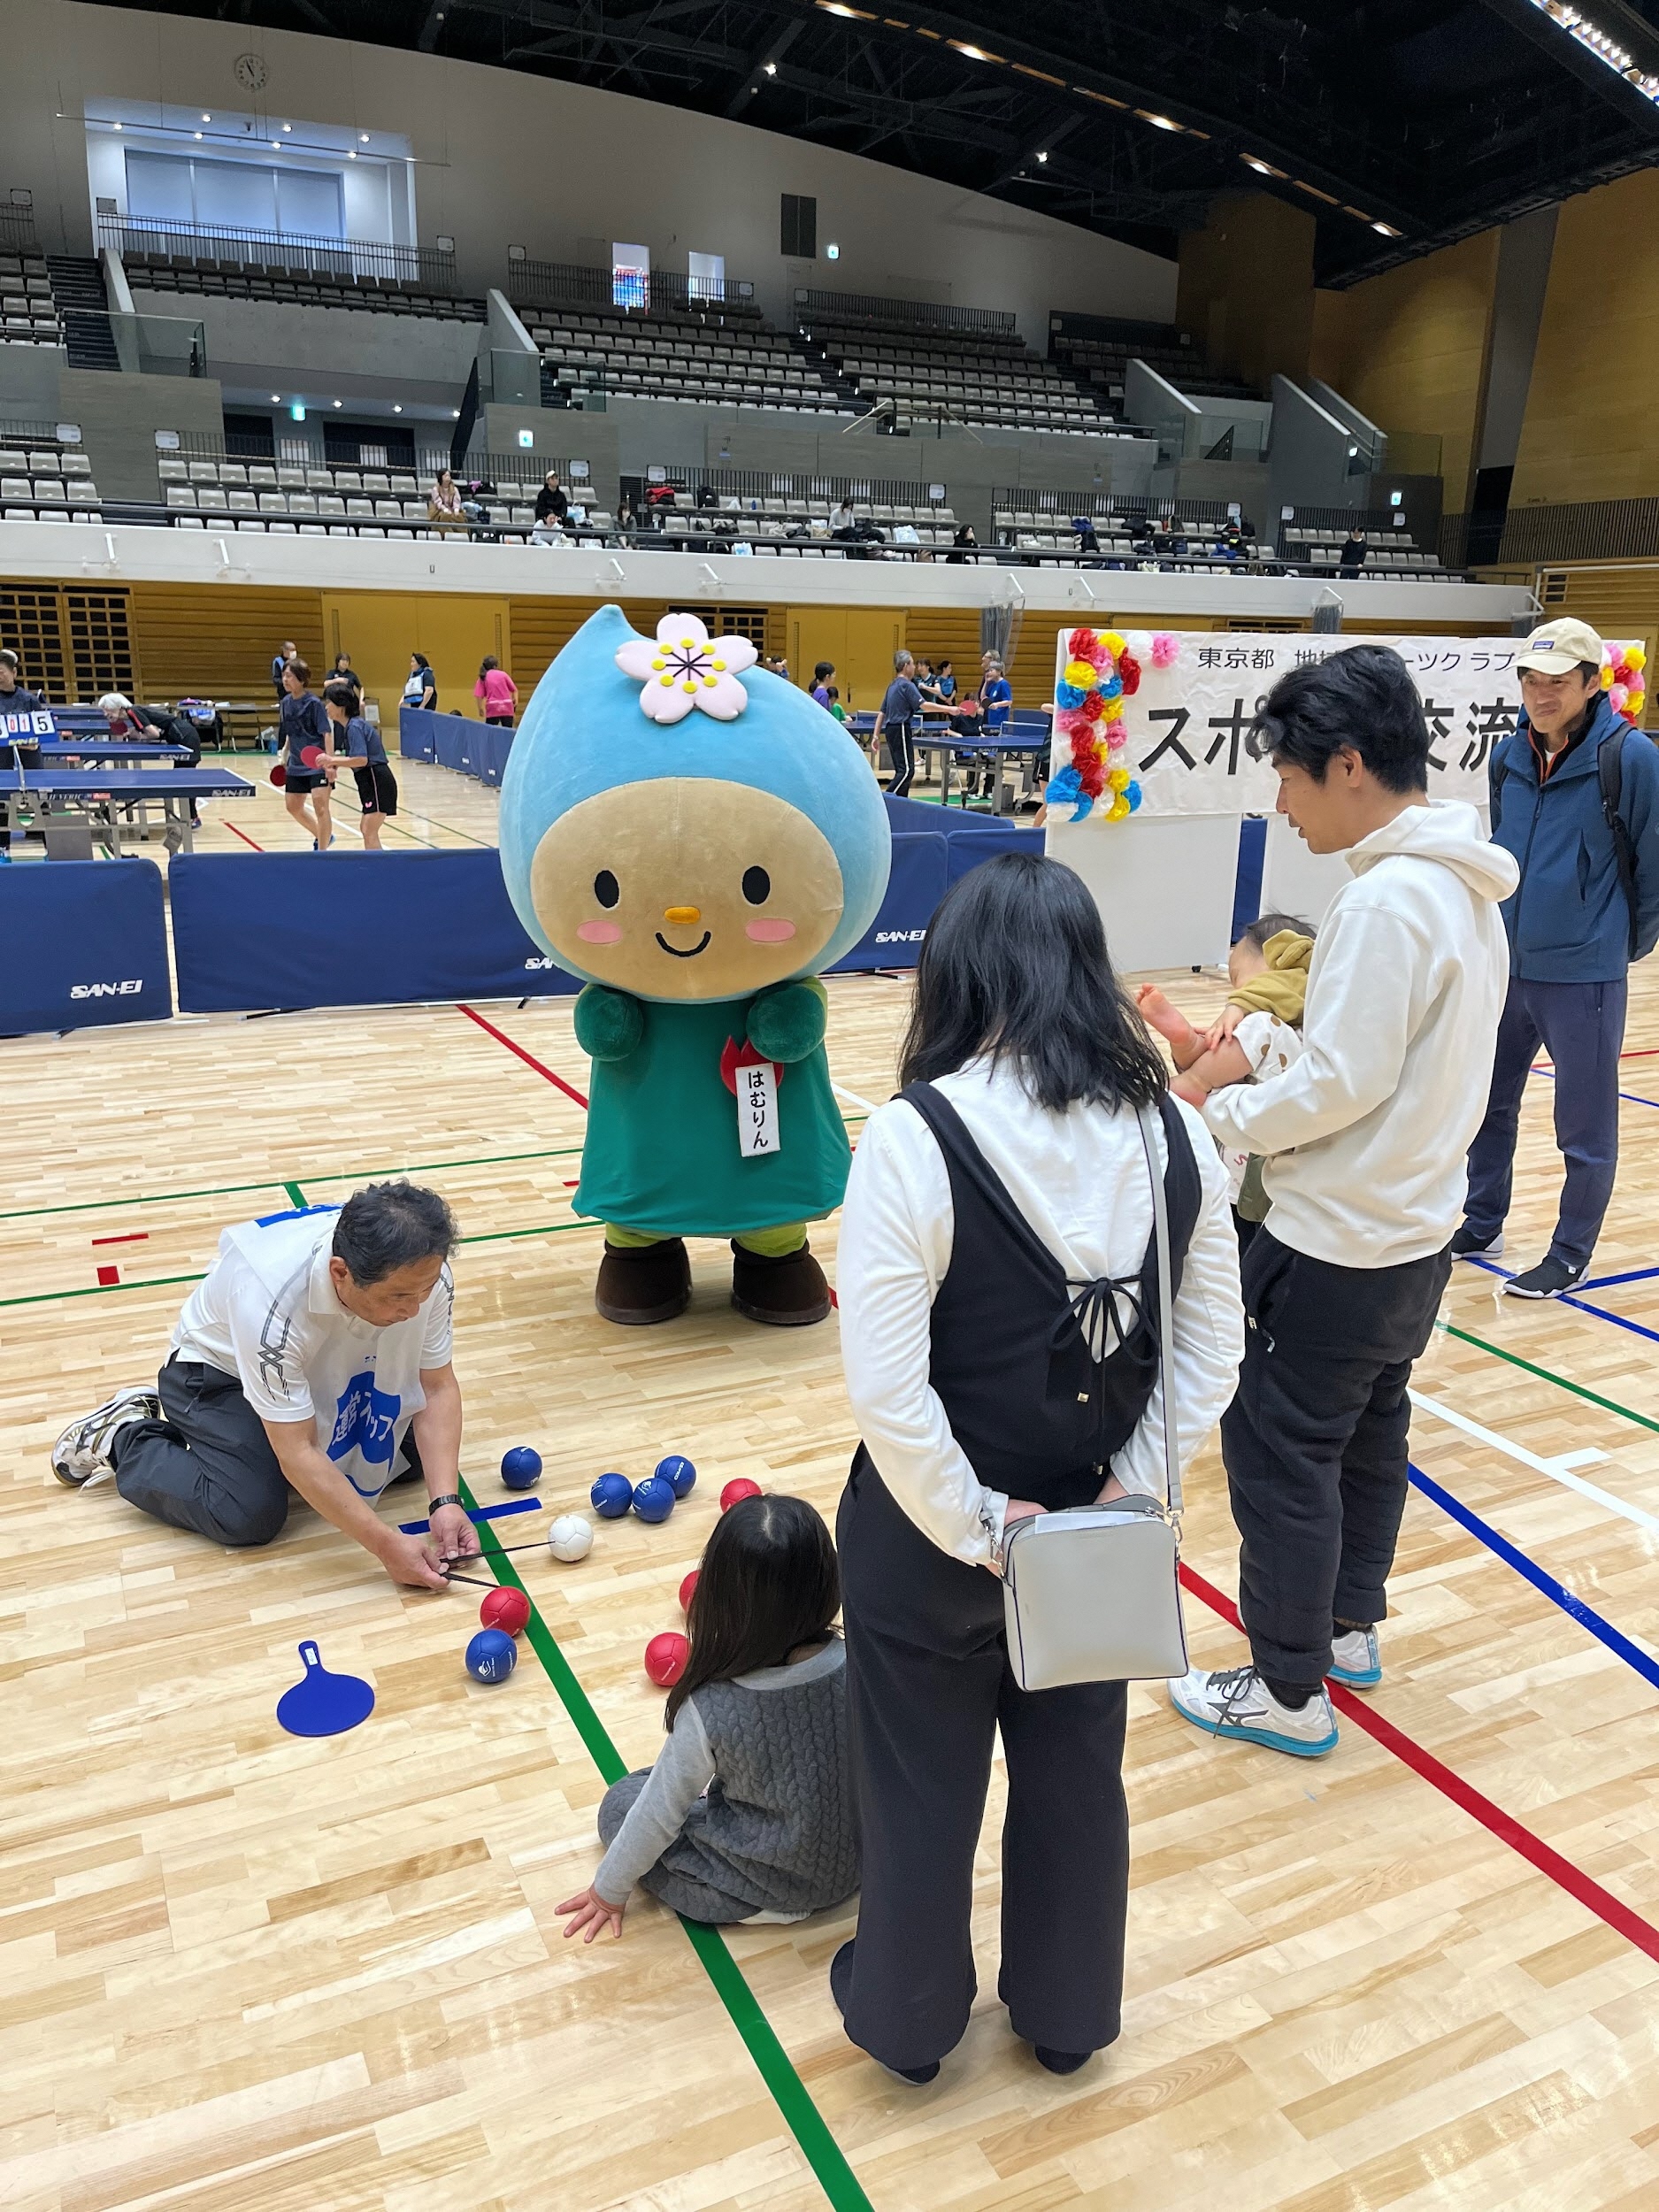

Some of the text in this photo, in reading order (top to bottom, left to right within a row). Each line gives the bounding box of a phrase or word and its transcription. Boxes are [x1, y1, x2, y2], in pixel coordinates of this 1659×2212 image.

[1198, 647, 1274, 670] 東京都
[211, 788, 251, 797] SAN-EI
[875, 929, 927, 943] SAN-EI
[70, 979, 143, 1000] SAN-EI
[748, 1071, 769, 1149] はむりん
